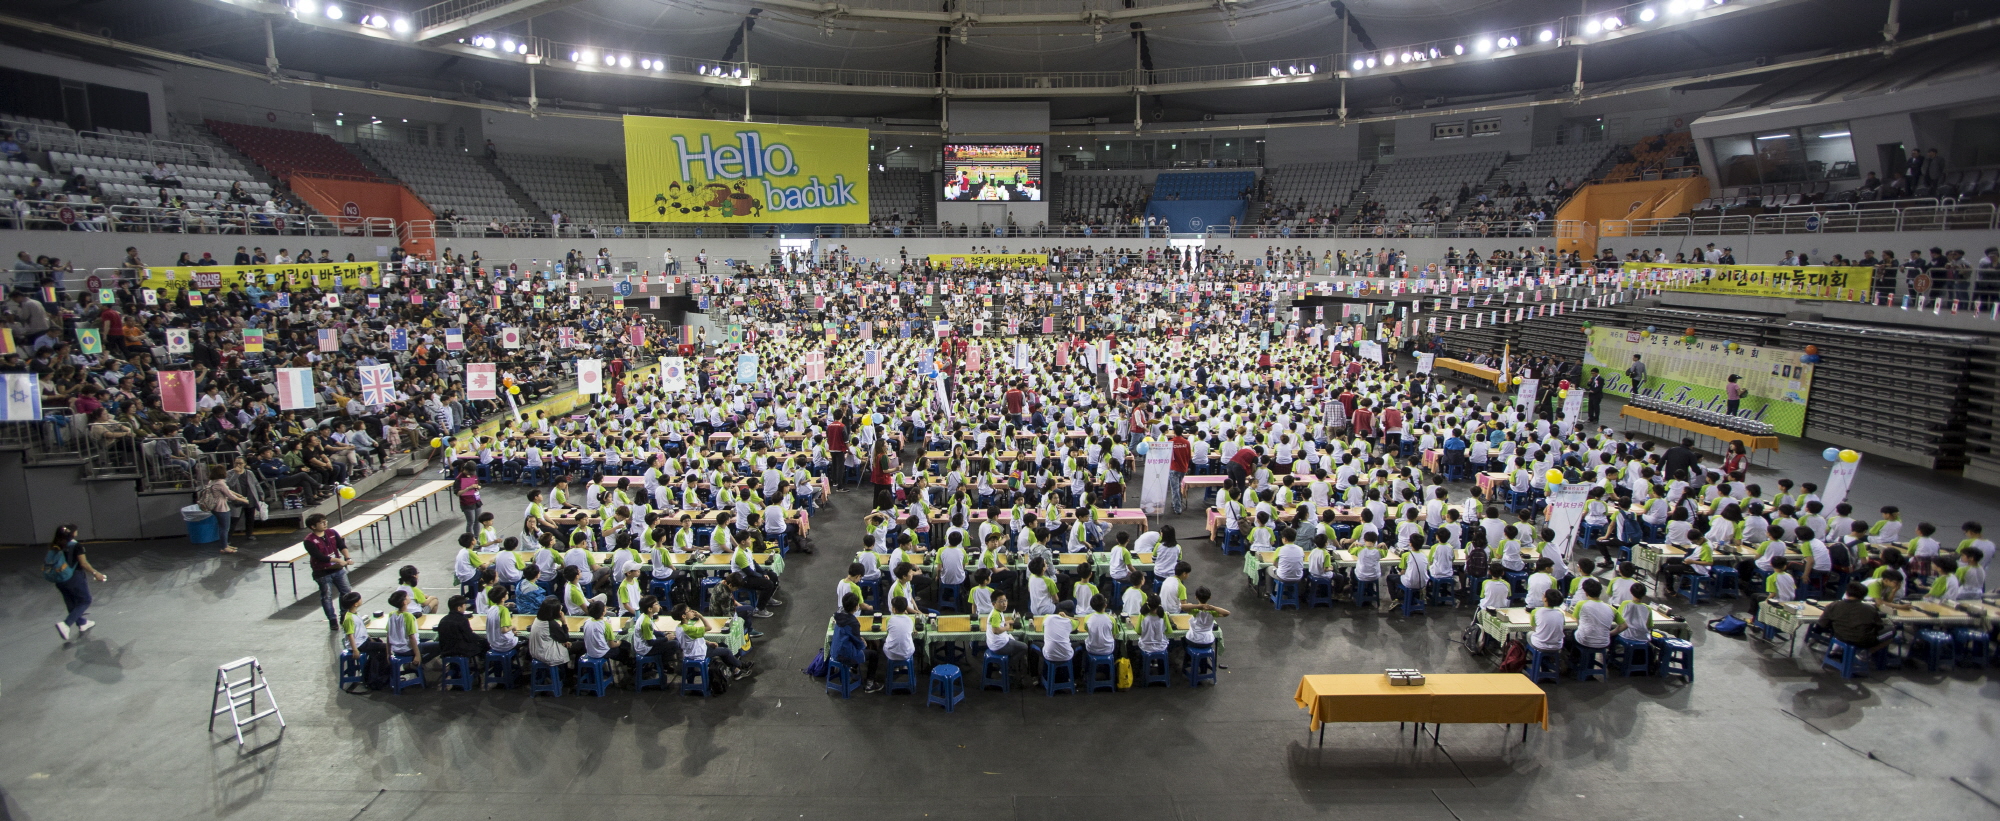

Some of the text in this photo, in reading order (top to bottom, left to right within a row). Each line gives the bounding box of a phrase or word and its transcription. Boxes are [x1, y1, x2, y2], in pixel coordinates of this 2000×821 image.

[671, 131, 799, 182] Hello,
[762, 175, 858, 211] baduk
[346, 206, 358, 215] N3
[1717, 269, 1764, 286] 어린이
[1772, 269, 1849, 290] 바둑대회
[1917, 279, 1926, 287] 21
[1669, 386, 1770, 421] Festial
